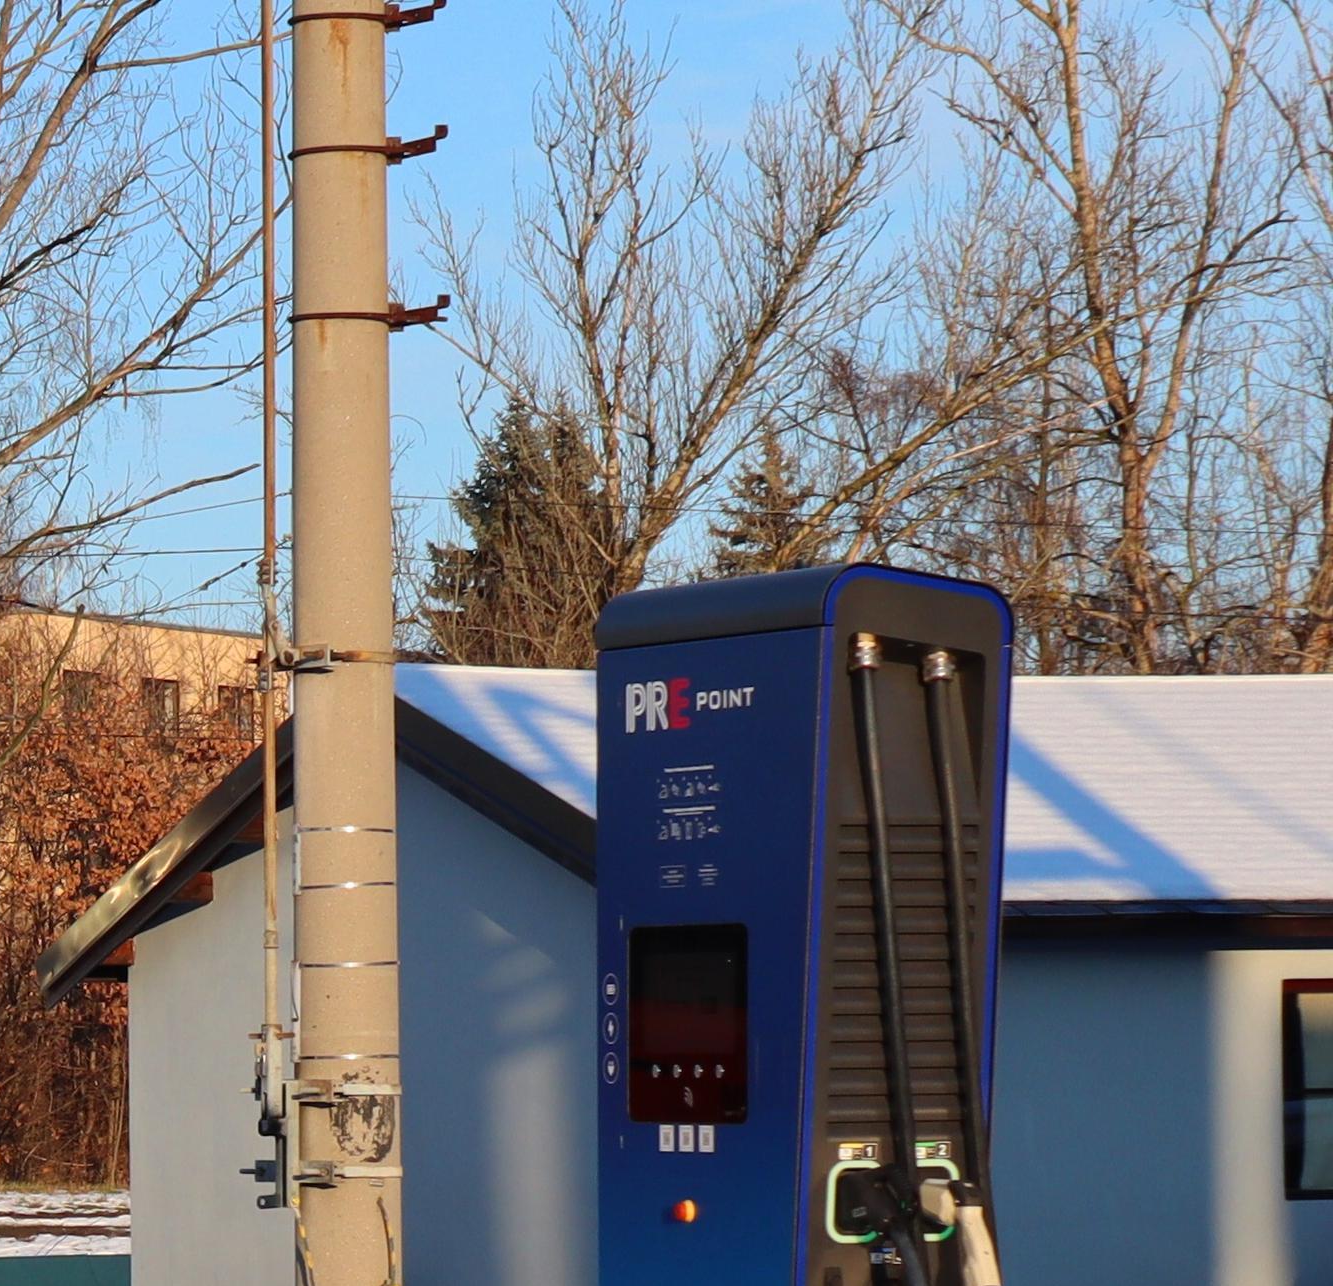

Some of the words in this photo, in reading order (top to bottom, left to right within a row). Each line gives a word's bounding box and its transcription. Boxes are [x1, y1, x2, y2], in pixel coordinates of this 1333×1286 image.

[625, 677, 691, 734] PRE
[695, 686, 755, 712] POINT
[865, 1146, 874, 1157] 1
[938, 1144, 948, 1156] 2
